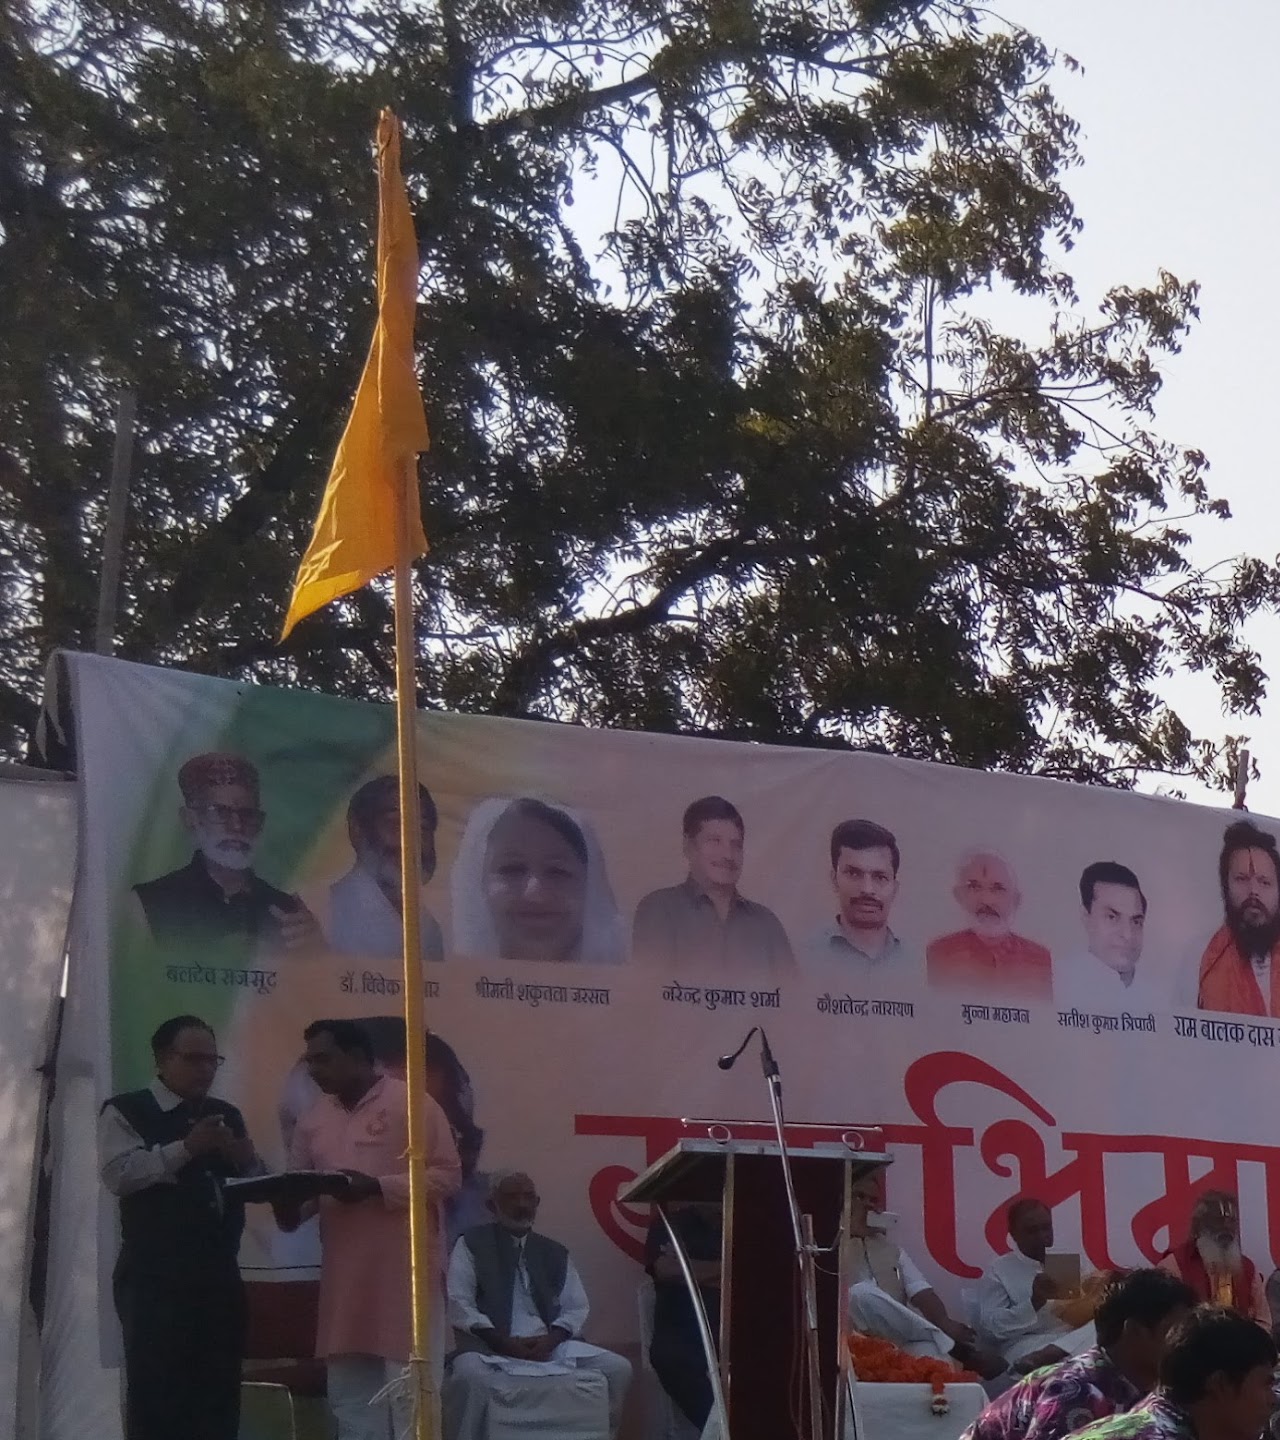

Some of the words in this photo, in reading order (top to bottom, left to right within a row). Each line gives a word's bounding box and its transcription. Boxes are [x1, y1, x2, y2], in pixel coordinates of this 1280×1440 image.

[362, 970, 402, 996] विवेक
[704, 988, 747, 1011] कुमार
[750, 987, 781, 1008] शर्मा
[872, 1000, 915, 1018] नारायण
[961, 1003, 990, 1025] मुन्ना
[992, 1007, 1030, 1024] महाजन
[1057, 1007, 1089, 1029] सतीश
[1091, 1014, 1119, 1035] कुमार
[1121, 1011, 1156, 1032] त्रिपाठी
[1173, 1015, 1197, 1038] राम
[1200, 1019, 1244, 1043] बालक
[1247, 1024, 1275, 1047] दास
